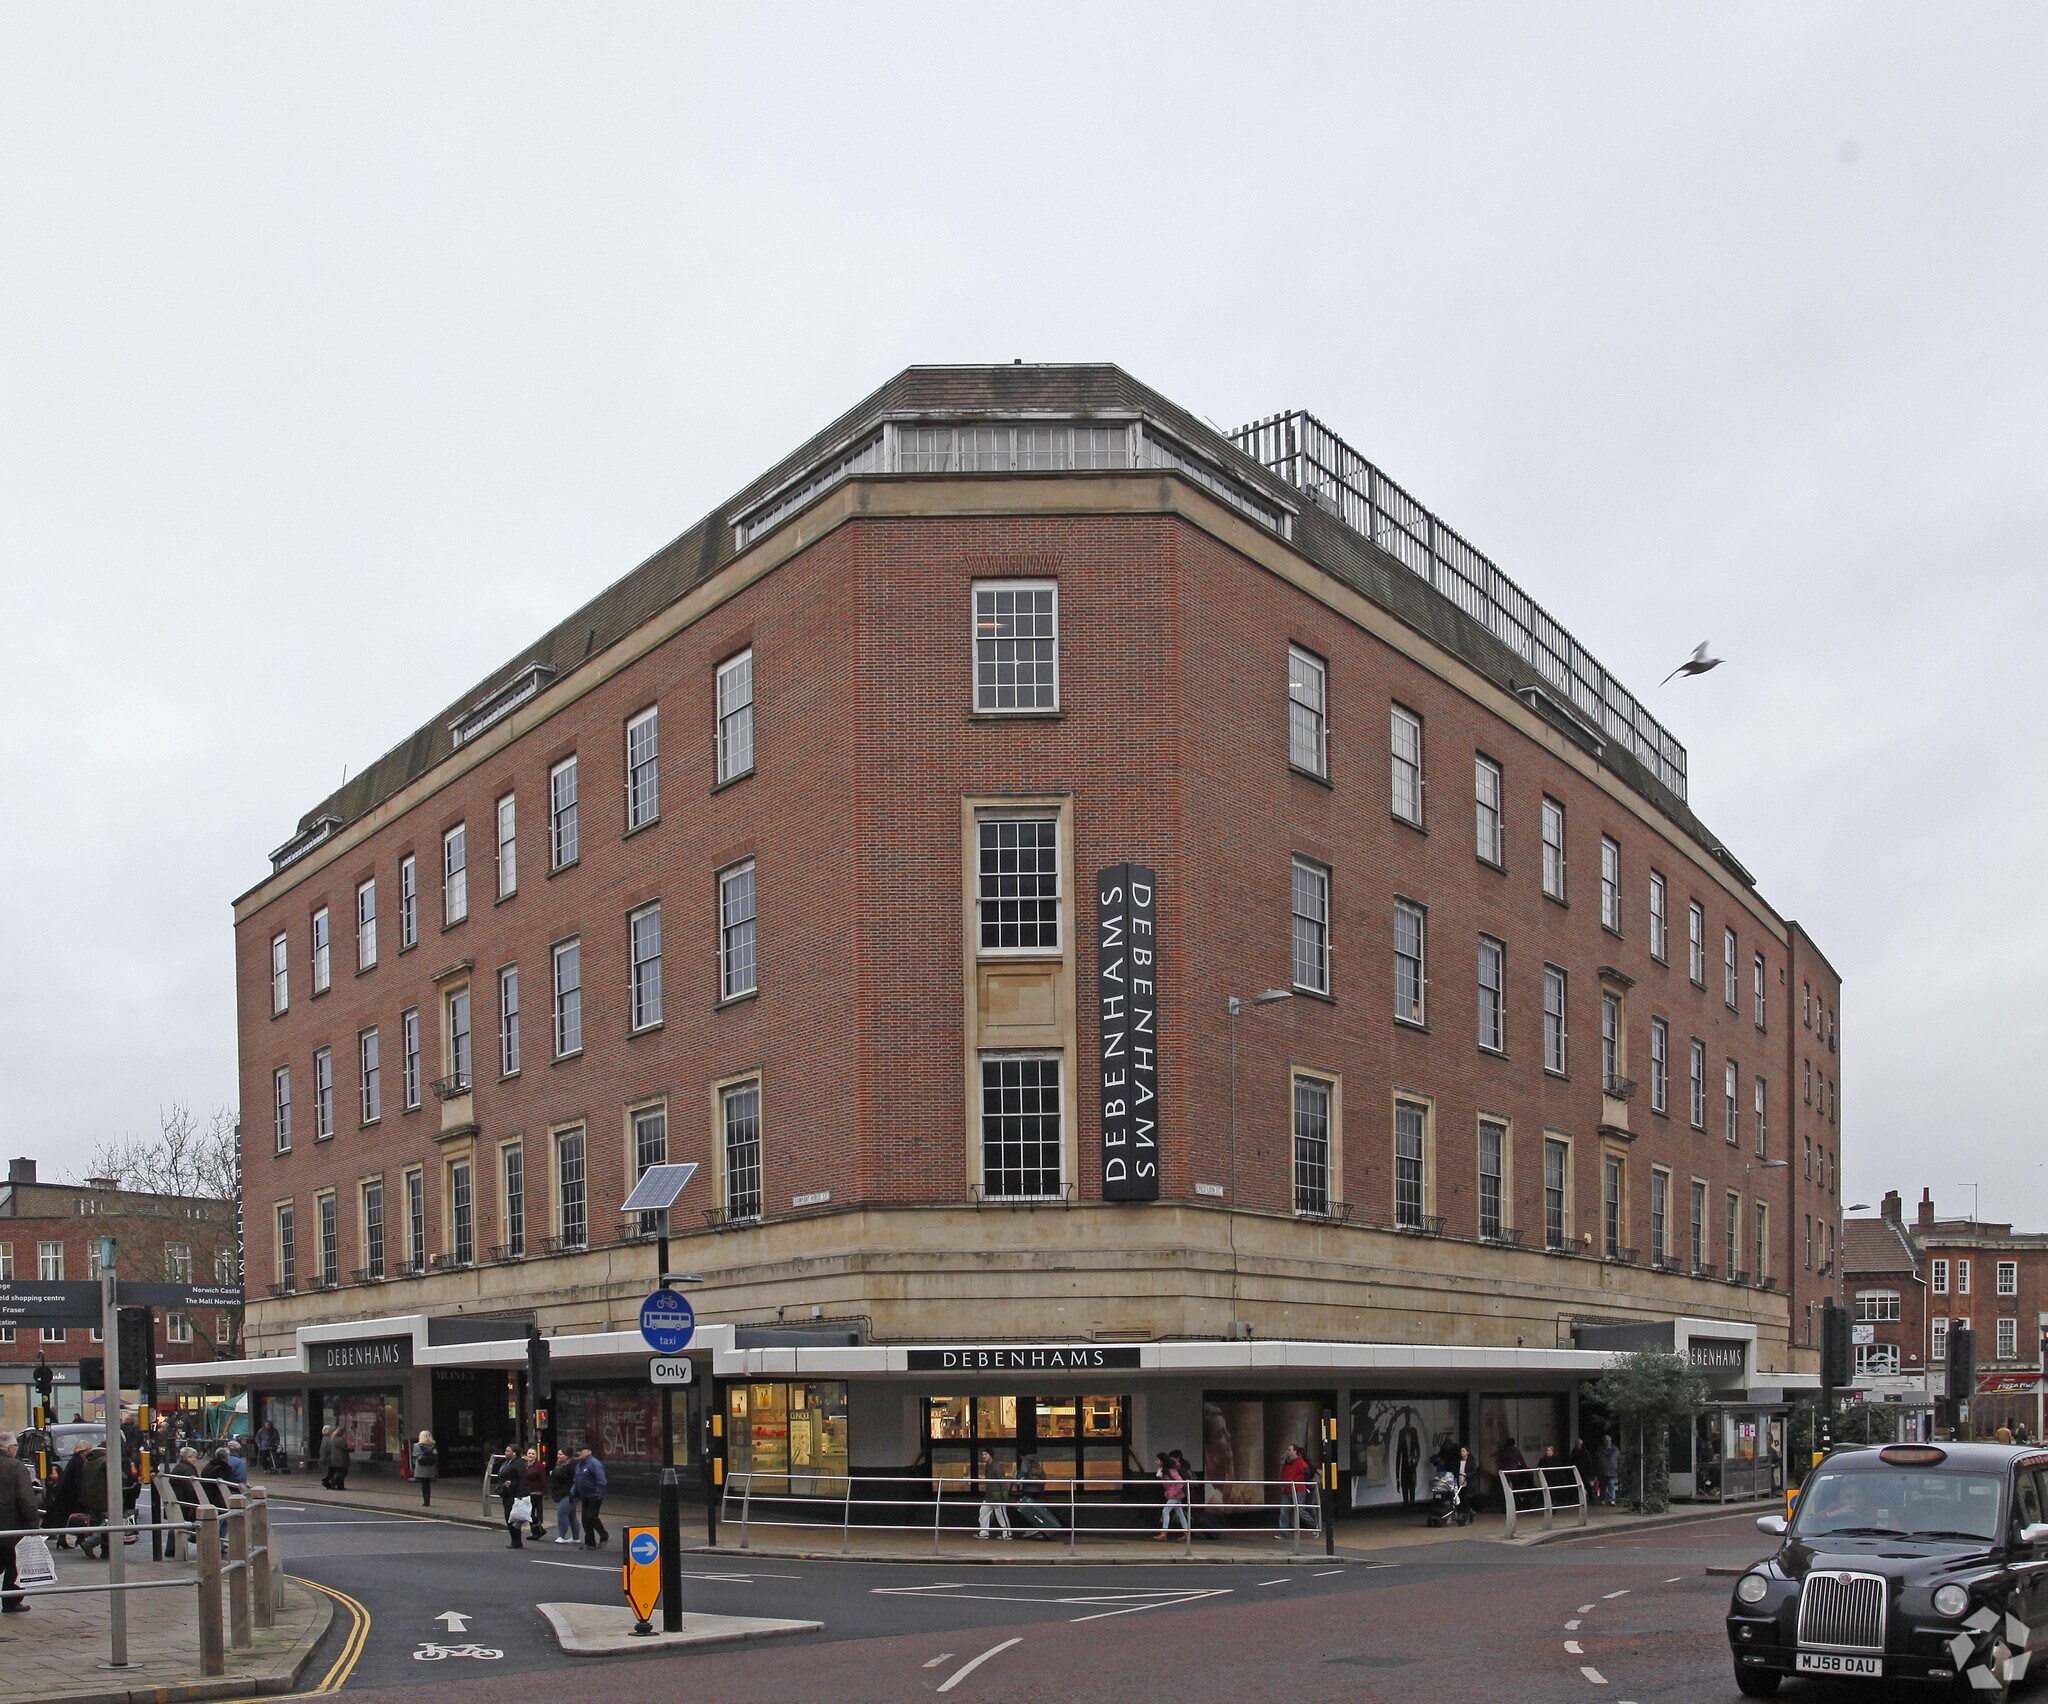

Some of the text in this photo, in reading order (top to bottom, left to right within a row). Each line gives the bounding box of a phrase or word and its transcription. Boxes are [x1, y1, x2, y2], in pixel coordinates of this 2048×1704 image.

[1101, 885, 1127, 1182] DEBENHAMS
[1132, 881, 1156, 1178] DEBENHAMS
[11, 1294, 42, 1303] shopping
[659, 1336, 677, 1345] taxi
[327, 1344, 399, 1367] DEBENHAMS
[943, 1351, 1104, 1367] DEBENHAMS
[1690, 1347, 1741, 1366] EBENHAMS
[656, 1364, 687, 1379] Only
[603, 1425, 647, 1456] SALE
[1802, 1655, 1841, 1671] MJ58
